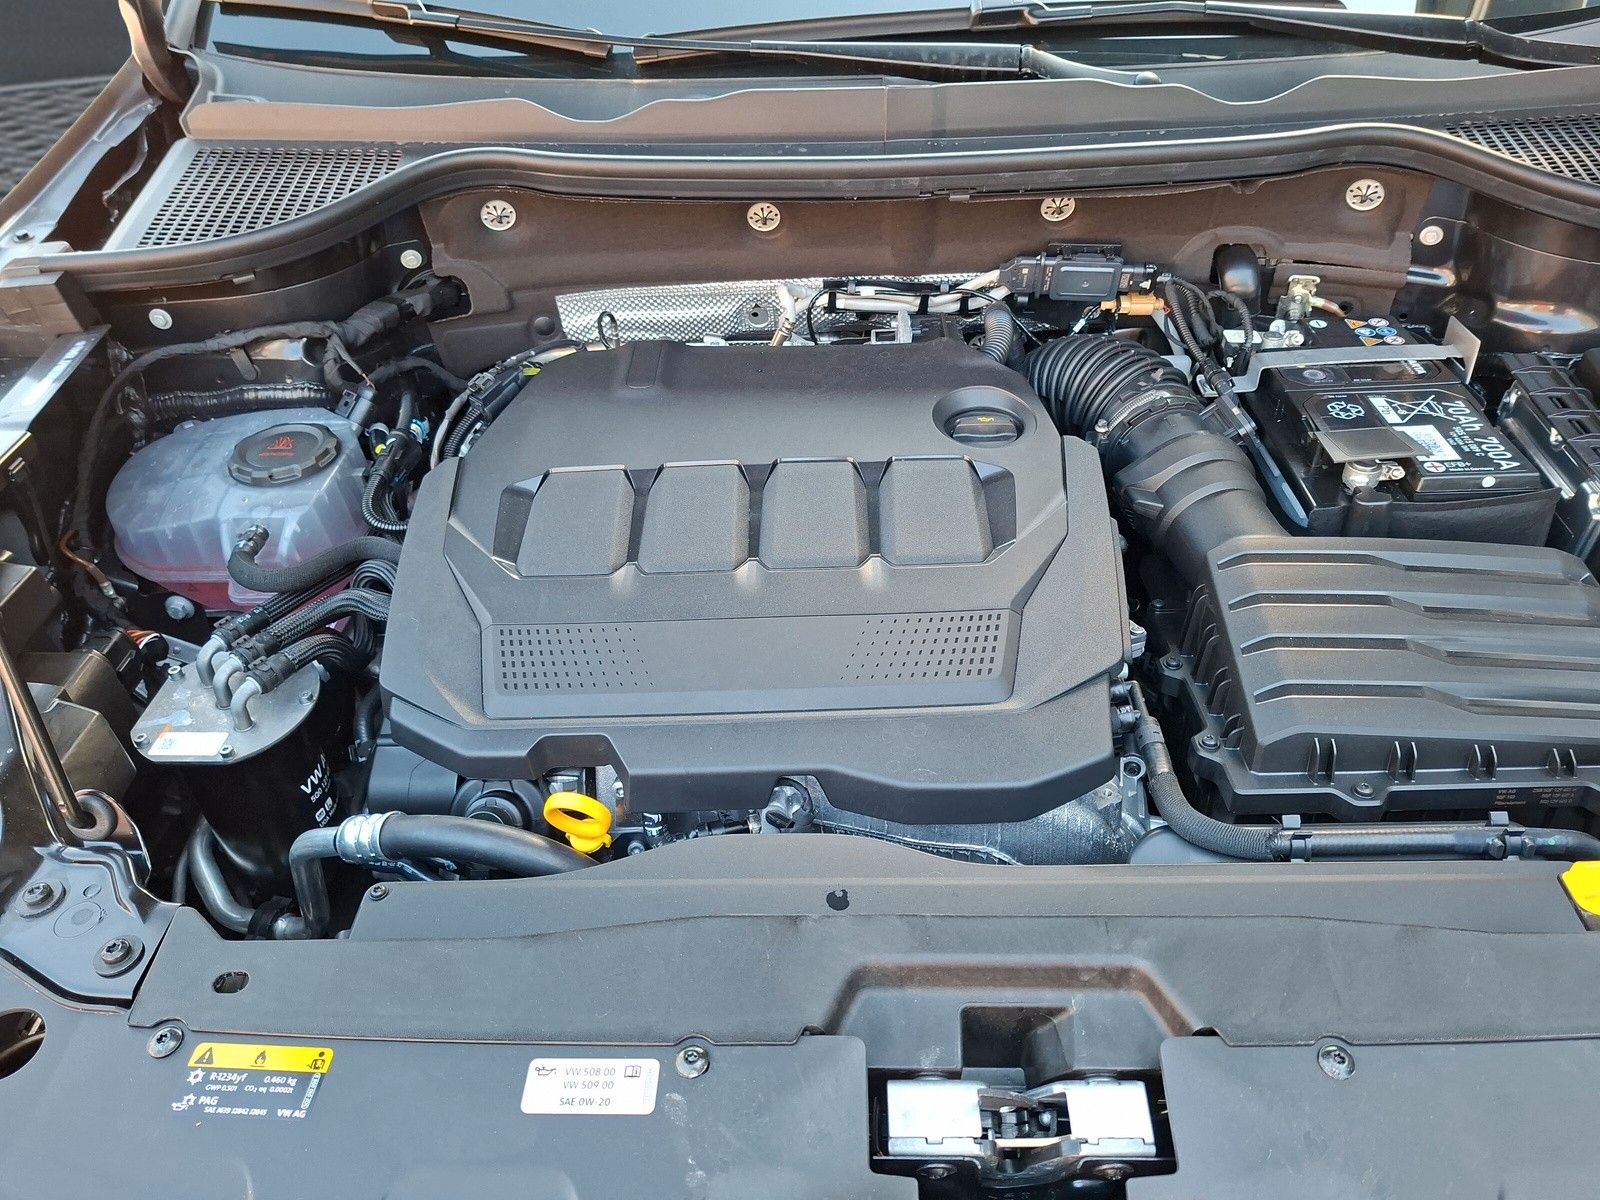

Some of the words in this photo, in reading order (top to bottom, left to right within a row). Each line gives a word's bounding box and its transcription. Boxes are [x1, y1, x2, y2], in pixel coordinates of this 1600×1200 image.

[1441, 400, 1484, 432] 70Ah
[1473, 436, 1520, 471] 700A
[300, 763, 323, 794] VW
[565, 1067, 580, 1077] VW
[584, 1067, 601, 1077] 508
[603, 1067, 616, 1077] 00
[209, 1072, 249, 1084] R-1234yf
[287, 1076, 298, 1086] kg
[563, 1080, 579, 1090] VW
[581, 1080, 600, 1090] 509
[602, 1080, 615, 1090] 00
[198, 1096, 220, 1106] PAG
[560, 1097, 576, 1106] SAE
[277, 1109, 292, 1118] VW
[292, 1109, 307, 1119] AG
